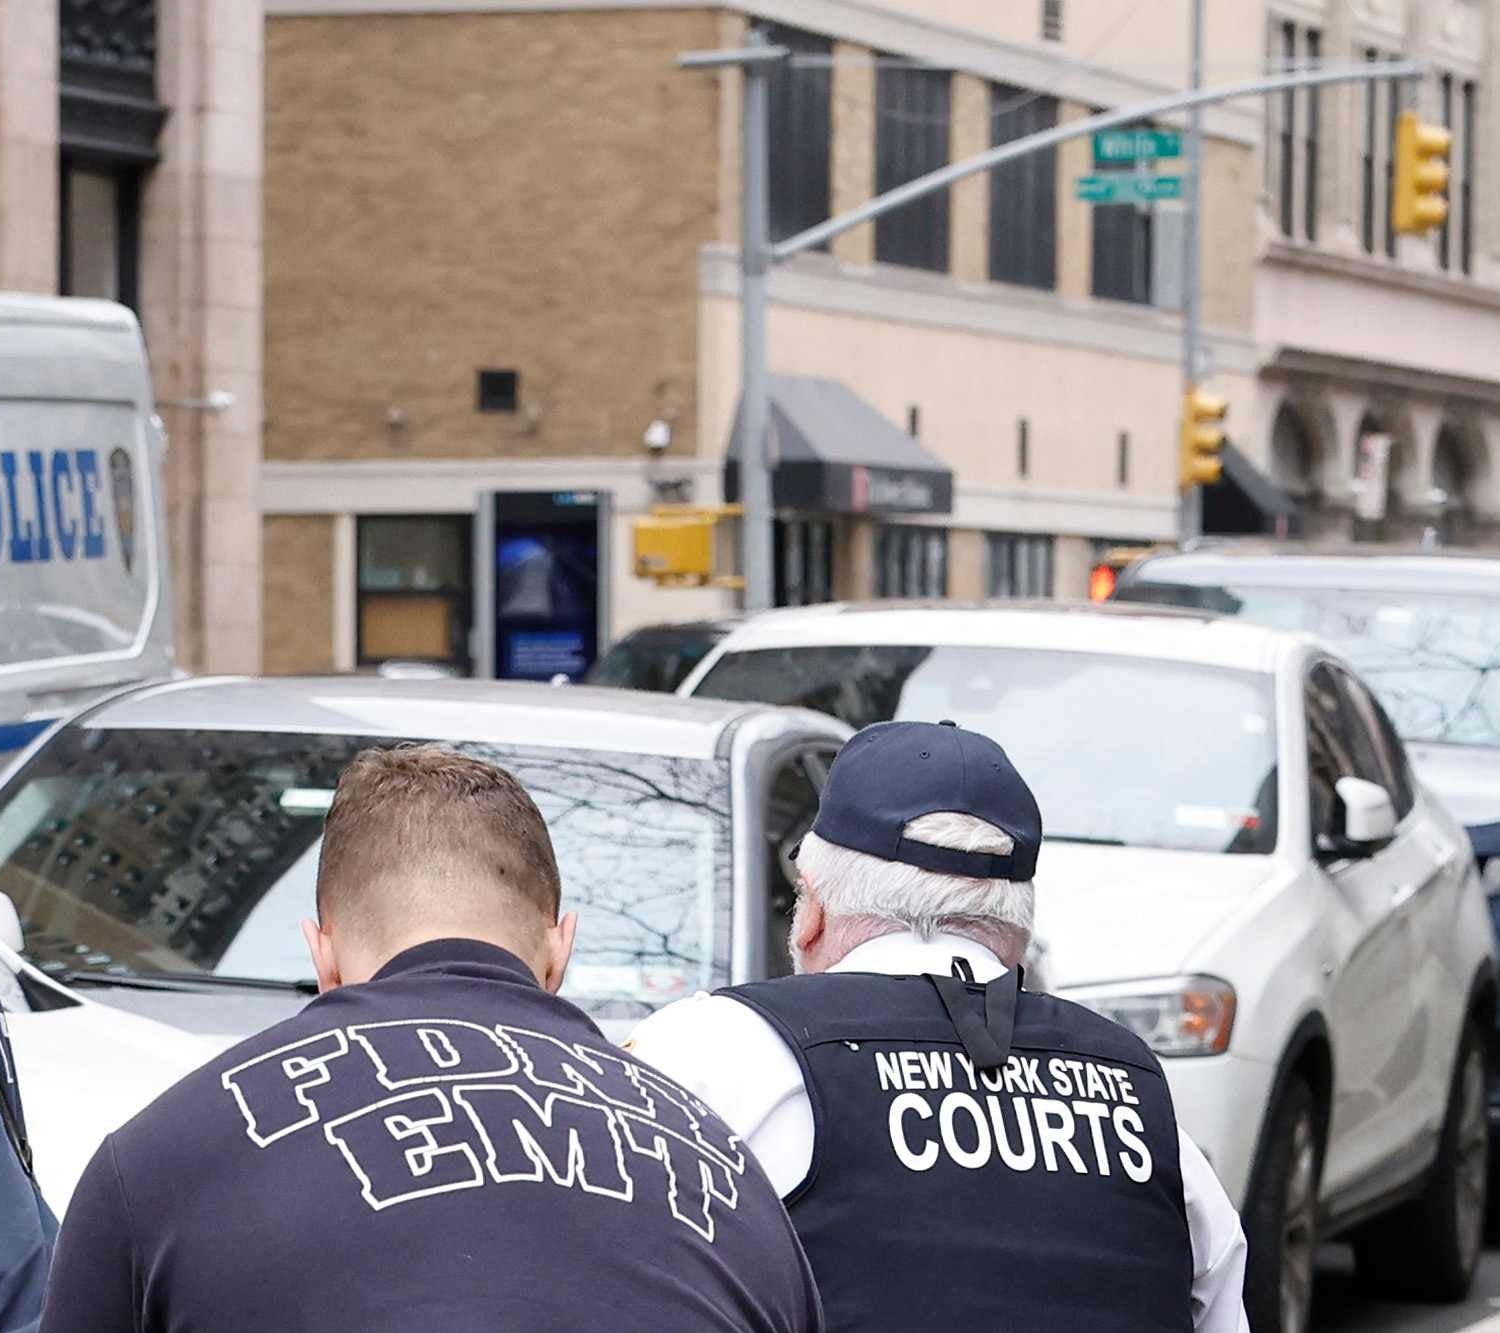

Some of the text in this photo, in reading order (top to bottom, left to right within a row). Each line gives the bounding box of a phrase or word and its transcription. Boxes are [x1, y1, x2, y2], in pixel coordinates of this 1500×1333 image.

[875, 1051, 1140, 1105] NEW YORK STATE
[324, 1085, 738, 1243] EMT
[888, 1091, 1153, 1184] COURTS
